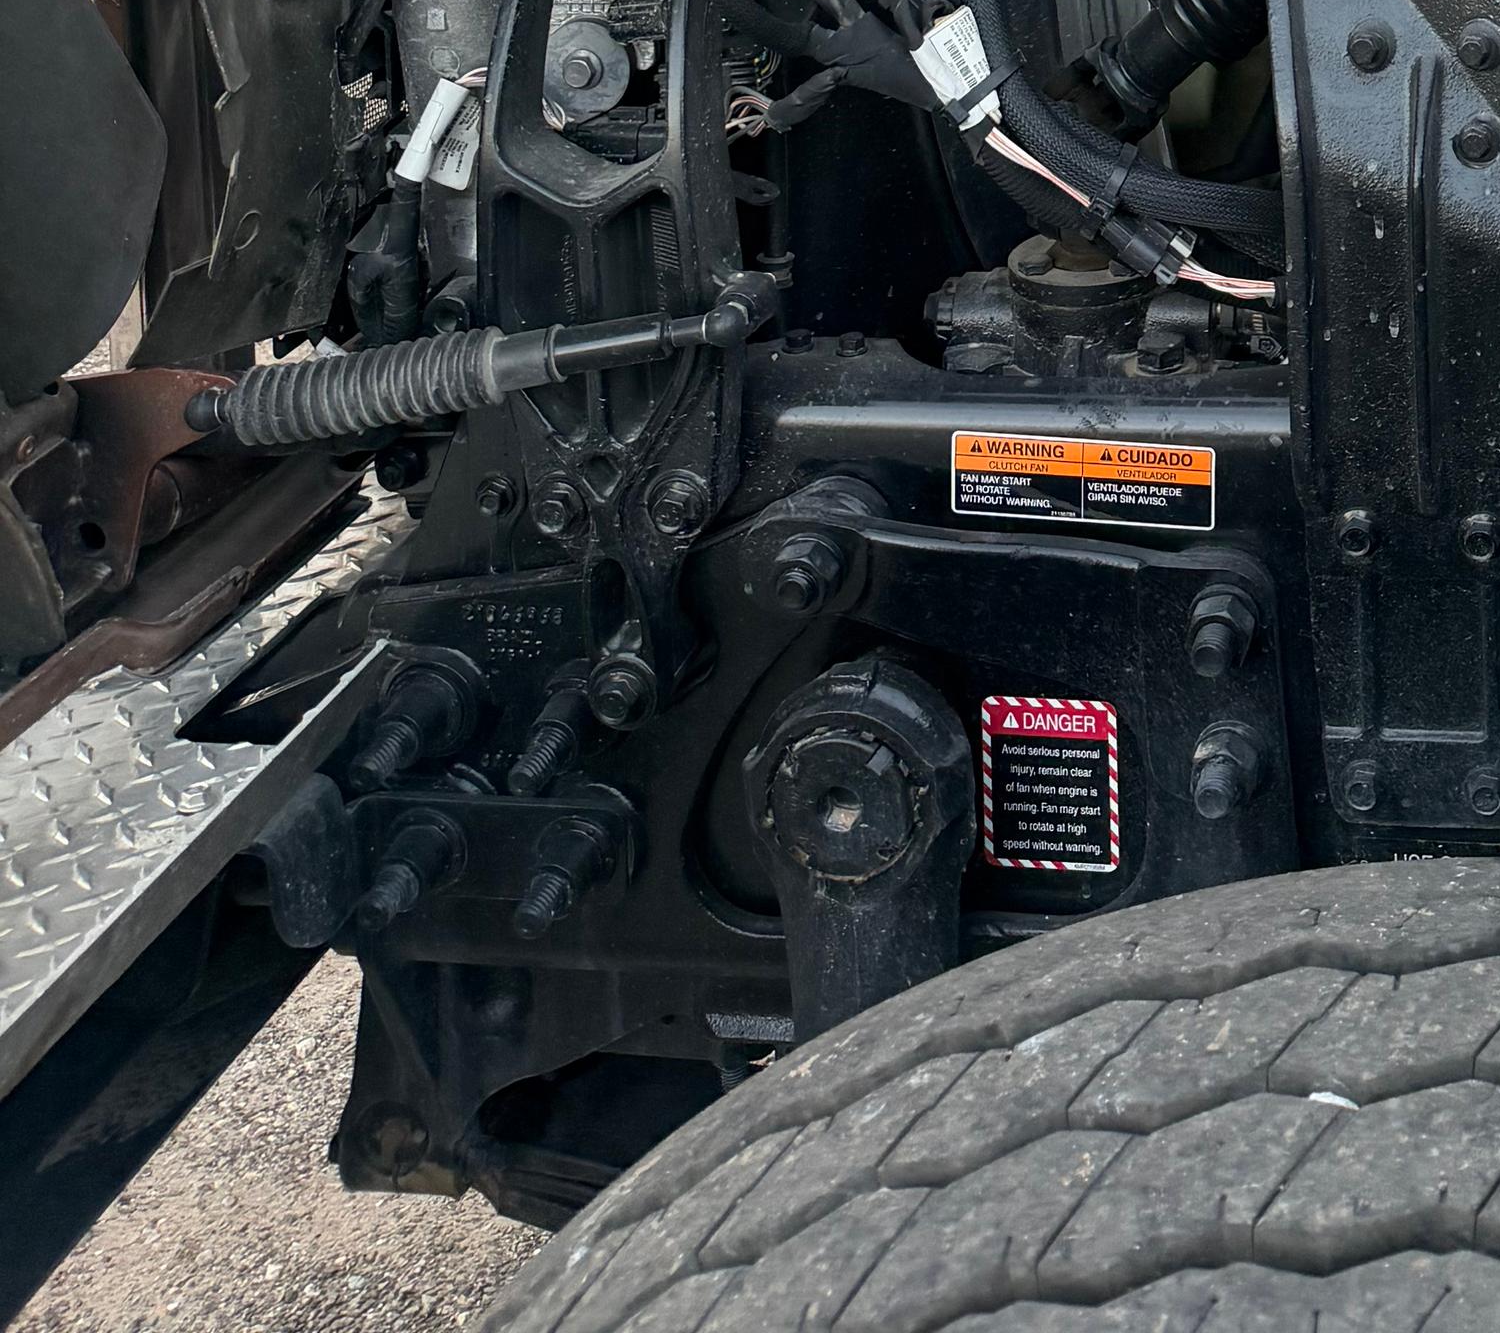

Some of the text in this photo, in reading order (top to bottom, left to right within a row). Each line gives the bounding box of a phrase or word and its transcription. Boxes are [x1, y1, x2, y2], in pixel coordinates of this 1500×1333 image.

[987, 440, 1065, 458] WARNING
[1117, 449, 1193, 467] CUIDADO
[989, 461, 1049, 473] CLUTCH FAN
[961, 474, 1032, 486] FAN MAY START
[1117, 469, 1177, 481] VENTILADOR
[961, 484, 1011, 495] TO ROTATE
[1088, 482, 1182, 497] VENTILADOR PUEDE
[961, 494, 1053, 508] WITHOUT WARNING.
[1088, 492, 1168, 507] GIRAR SIN AVISO.
[1023, 712, 1096, 733] DANGER
[1002, 743, 1100, 759] Avoid serious personal
[1010, 763, 1092, 778] injury, remain clear
[1006, 782, 1098, 798] of fan when engine is
[1004, 801, 1101, 817] running. Fan may start
[1018, 821, 1087, 836] to rotate at high
[1003, 839, 1103, 855] speed without warning.
